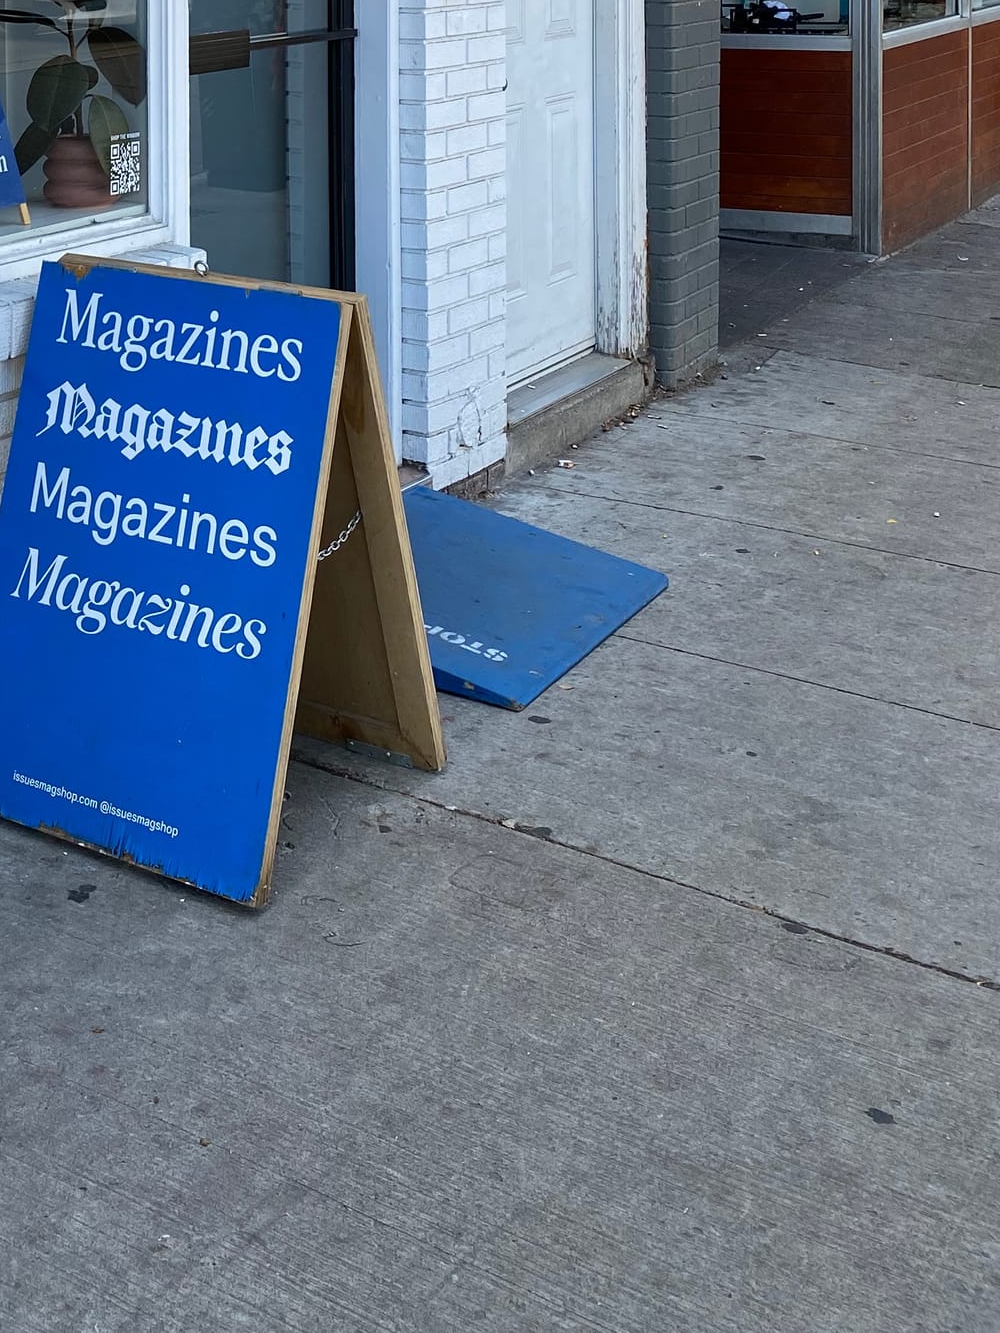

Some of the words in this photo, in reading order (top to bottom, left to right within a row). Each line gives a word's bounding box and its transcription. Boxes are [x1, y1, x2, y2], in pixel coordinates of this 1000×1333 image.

[55, 288, 304, 383] Magazines
[35, 380, 295, 476] Magazines
[29, 461, 278, 568] Magazines
[9, 546, 268, 660] Magazines
[12, 769, 99, 810] issuesmagshop.com
[99, 800, 179, 839] @issuesmagshop
